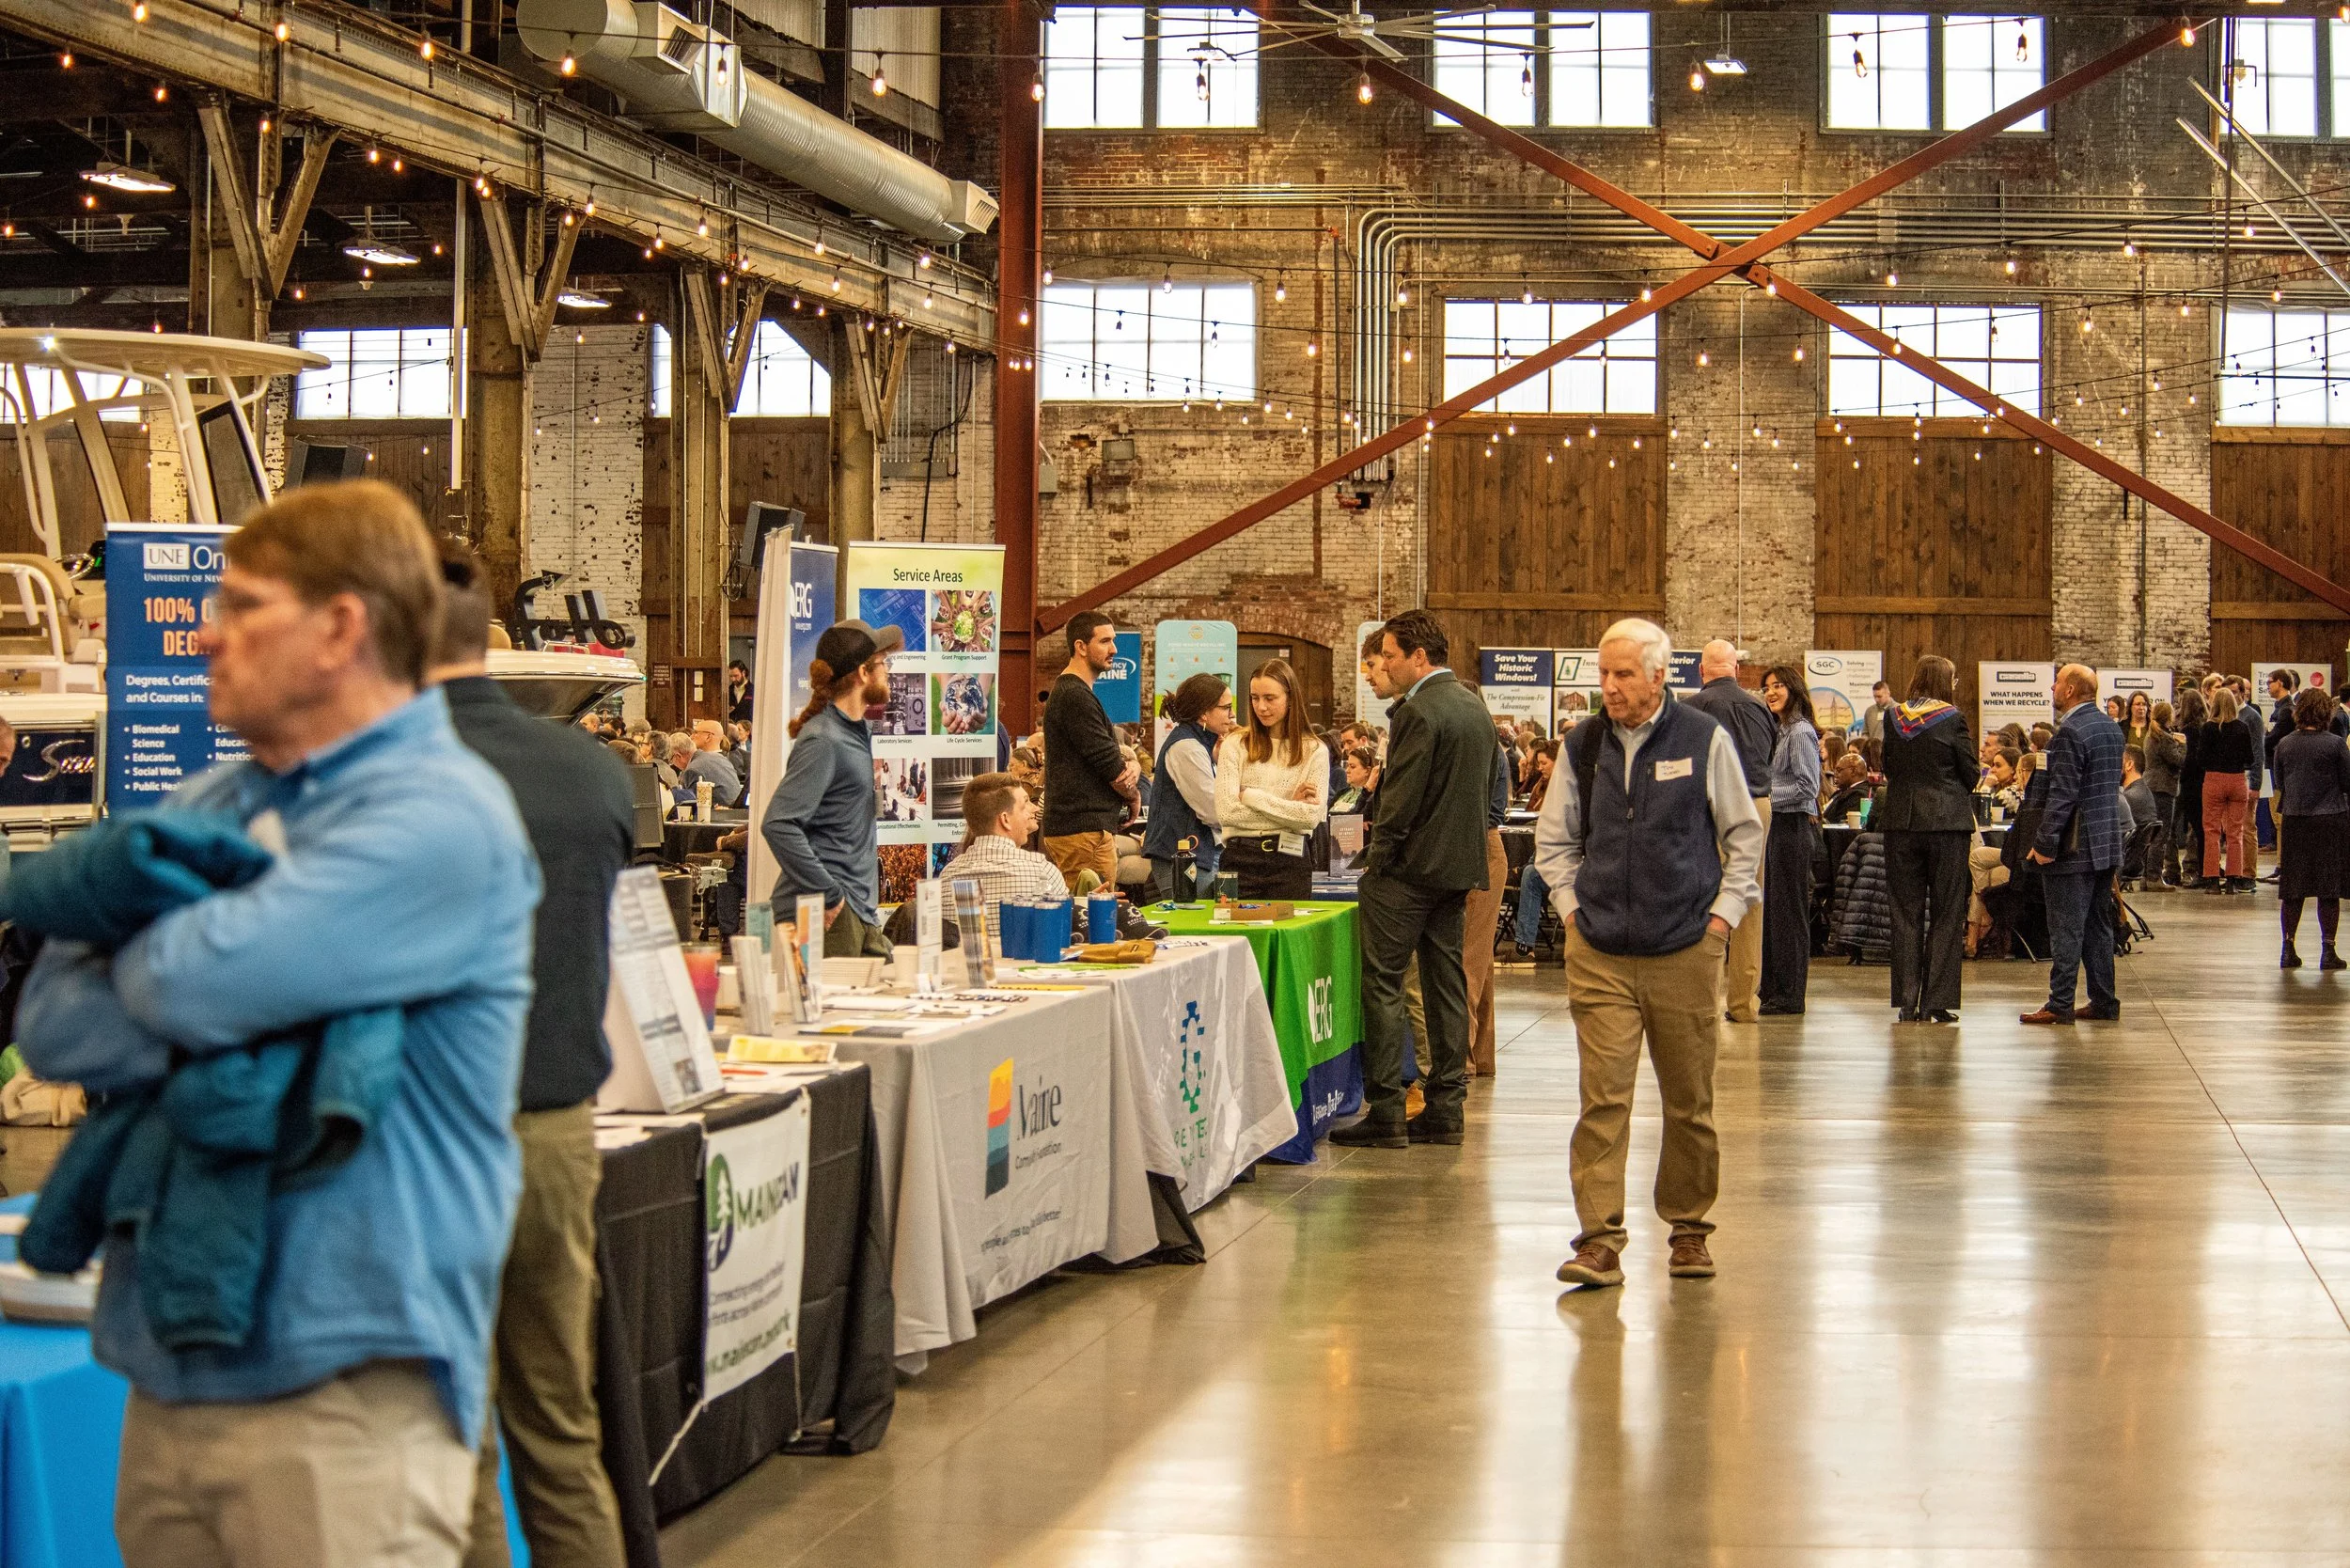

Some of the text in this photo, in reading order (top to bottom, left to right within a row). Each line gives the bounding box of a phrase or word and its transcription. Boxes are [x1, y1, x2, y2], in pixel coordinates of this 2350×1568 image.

[149, 548, 184, 565] UNE
[144, 572, 190, 582] UNIVERSITY
[192, 573, 202, 582] OF
[893, 569, 964, 583] Service Areas
[795, 582, 812, 619] ERG
[144, 597, 196, 623] 100%
[1495, 653, 1538, 663] Save Your
[1668, 656, 1696, 665] terior
[1498, 664, 1533, 672] Historic
[1097, 668, 1128, 680] AINE
[1495, 673, 1538, 682] Windows!
[126, 674, 171, 688] Degrees,
[126, 692, 204, 703] and Courses in:
[1498, 695, 1545, 703] Compression-Fit
[132, 724, 180, 734] Biomedical
[132, 739, 165, 748] Science
[133, 753, 176, 762] Education
[133, 766, 182, 776] Social Work
[133, 781, 160, 792] Public
[1315, 975, 1332, 1043] ERG
